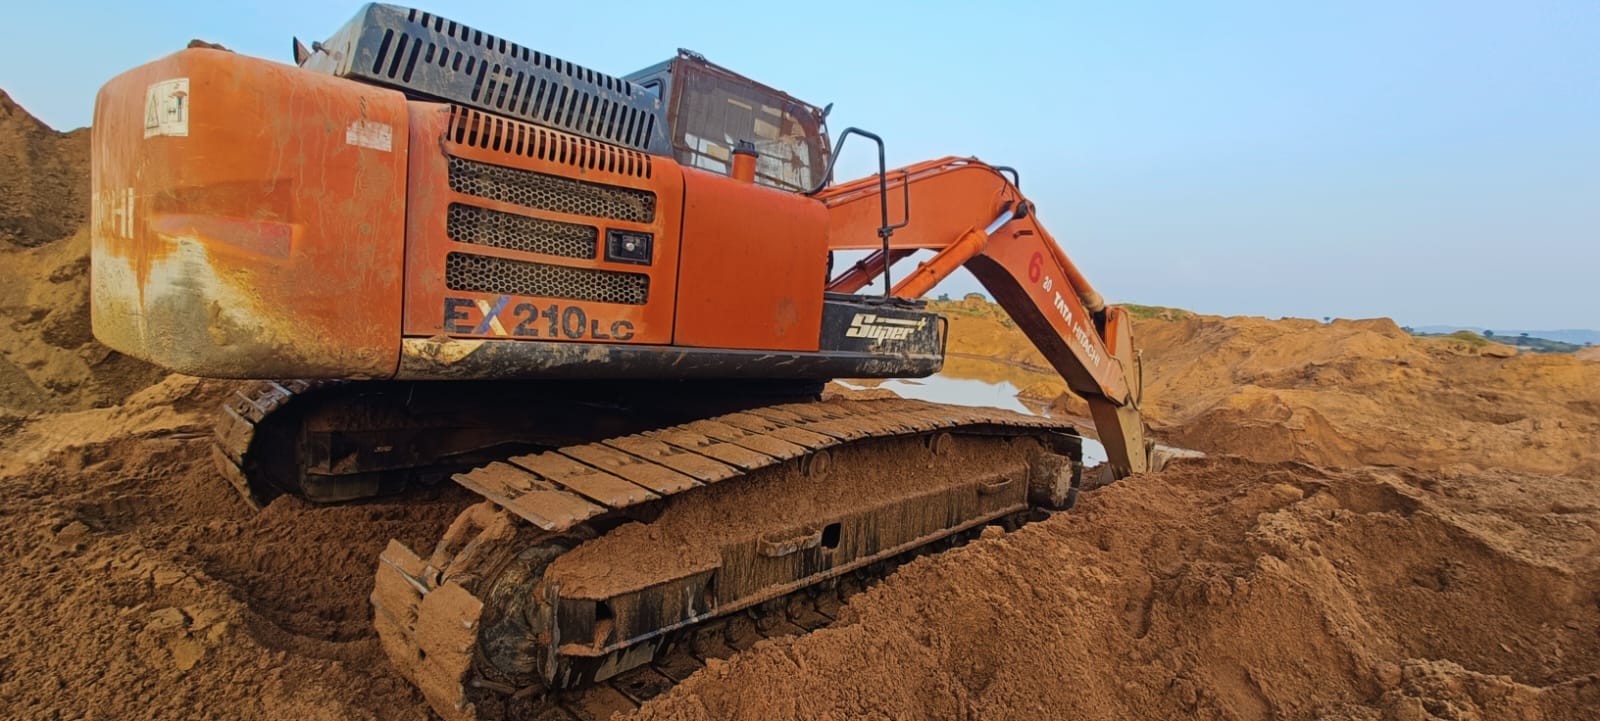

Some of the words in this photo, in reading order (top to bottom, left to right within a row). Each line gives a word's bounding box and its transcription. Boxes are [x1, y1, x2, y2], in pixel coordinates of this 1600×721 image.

[1028, 251, 1044, 284] 6
[1054, 291, 1073, 326] TATA
[1072, 321, 1100, 367] HITACHI
